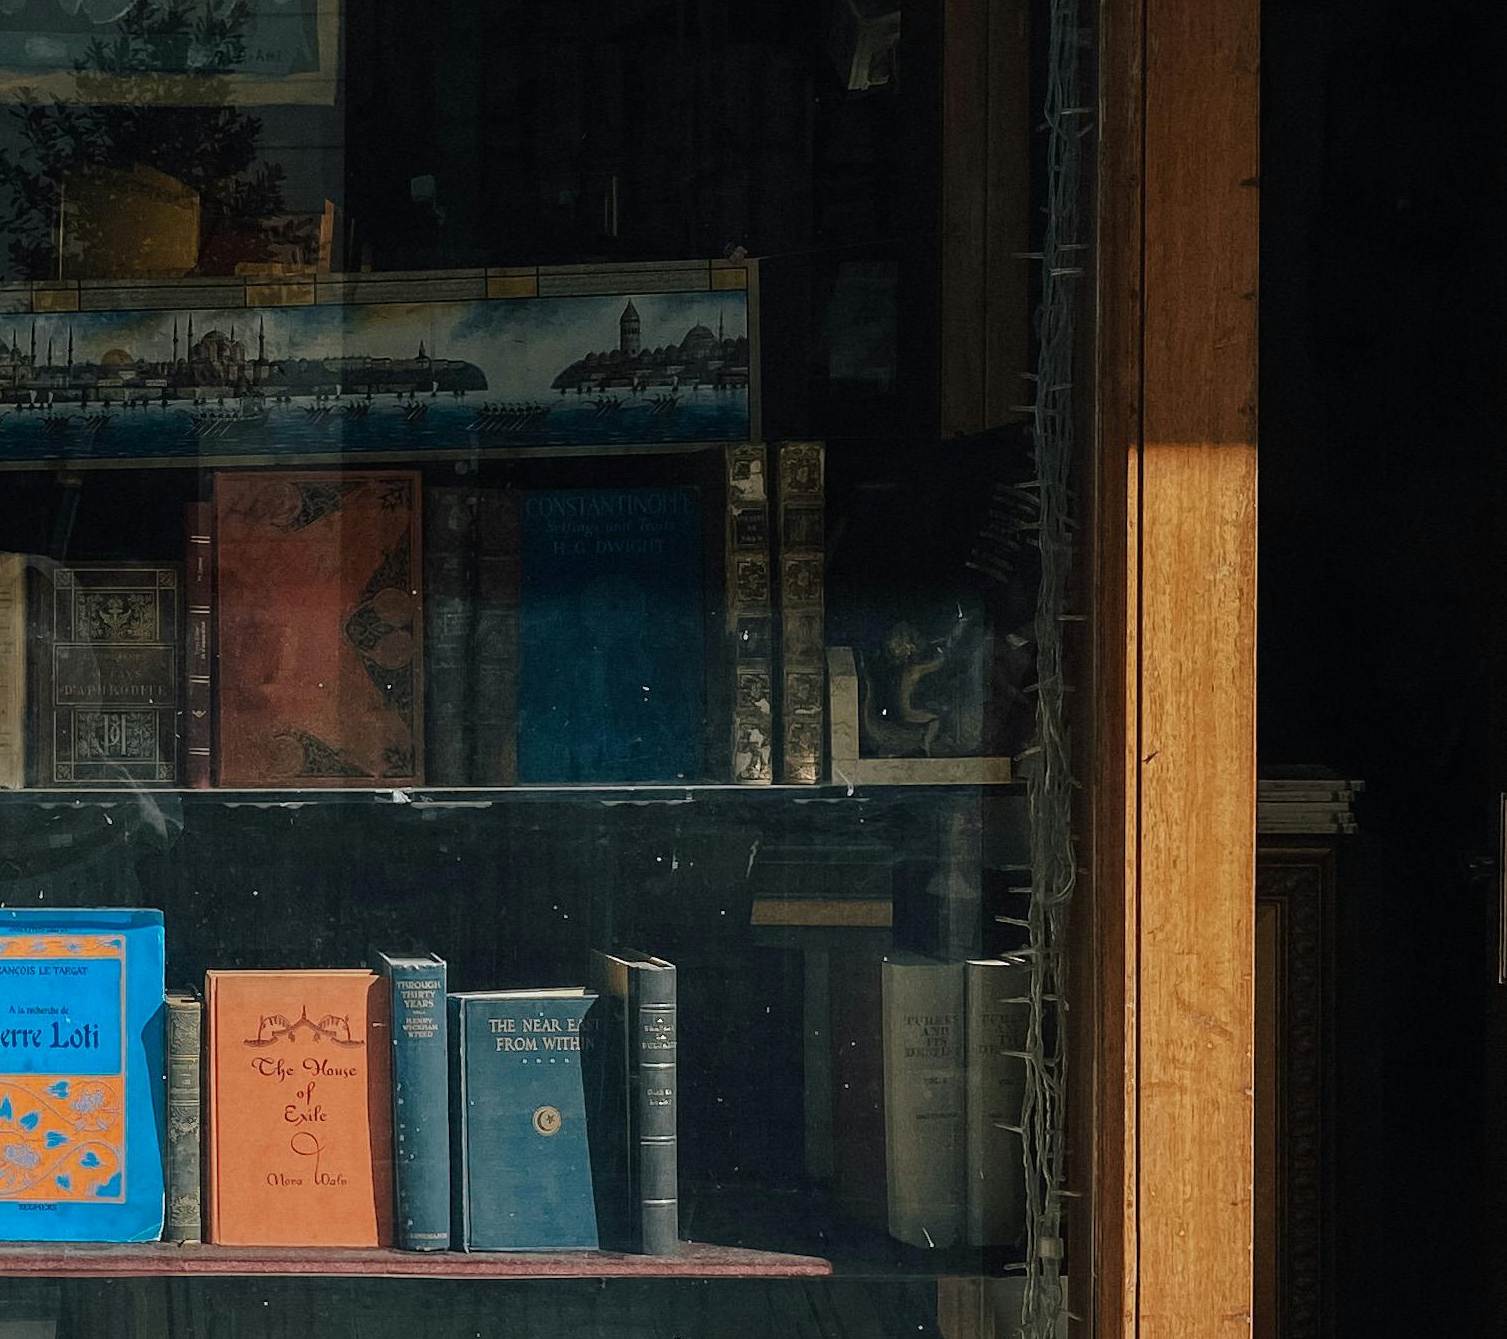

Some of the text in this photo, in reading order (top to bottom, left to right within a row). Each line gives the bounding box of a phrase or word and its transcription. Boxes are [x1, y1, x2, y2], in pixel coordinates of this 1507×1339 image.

[39, 966, 51, 975] LE
[396, 980, 441, 989] THROUGH
[401, 990, 435, 999] THIRTY
[26, 1006, 58, 1015] recherche
[60, 1006, 69, 1015] de
[404, 999, 434, 1008] YEARS
[489, 1018, 516, 1033] THE
[522, 1018, 562, 1033] NEAR
[49, 1020, 99, 1049] Loti
[496, 1036, 596, 1051] FROM WITHIN
[251, 1057, 358, 1083] The House
[296, 1081, 315, 1106] of
[284, 1104, 327, 1127] Exile
[266, 1170, 347, 1186] Nora Waln
